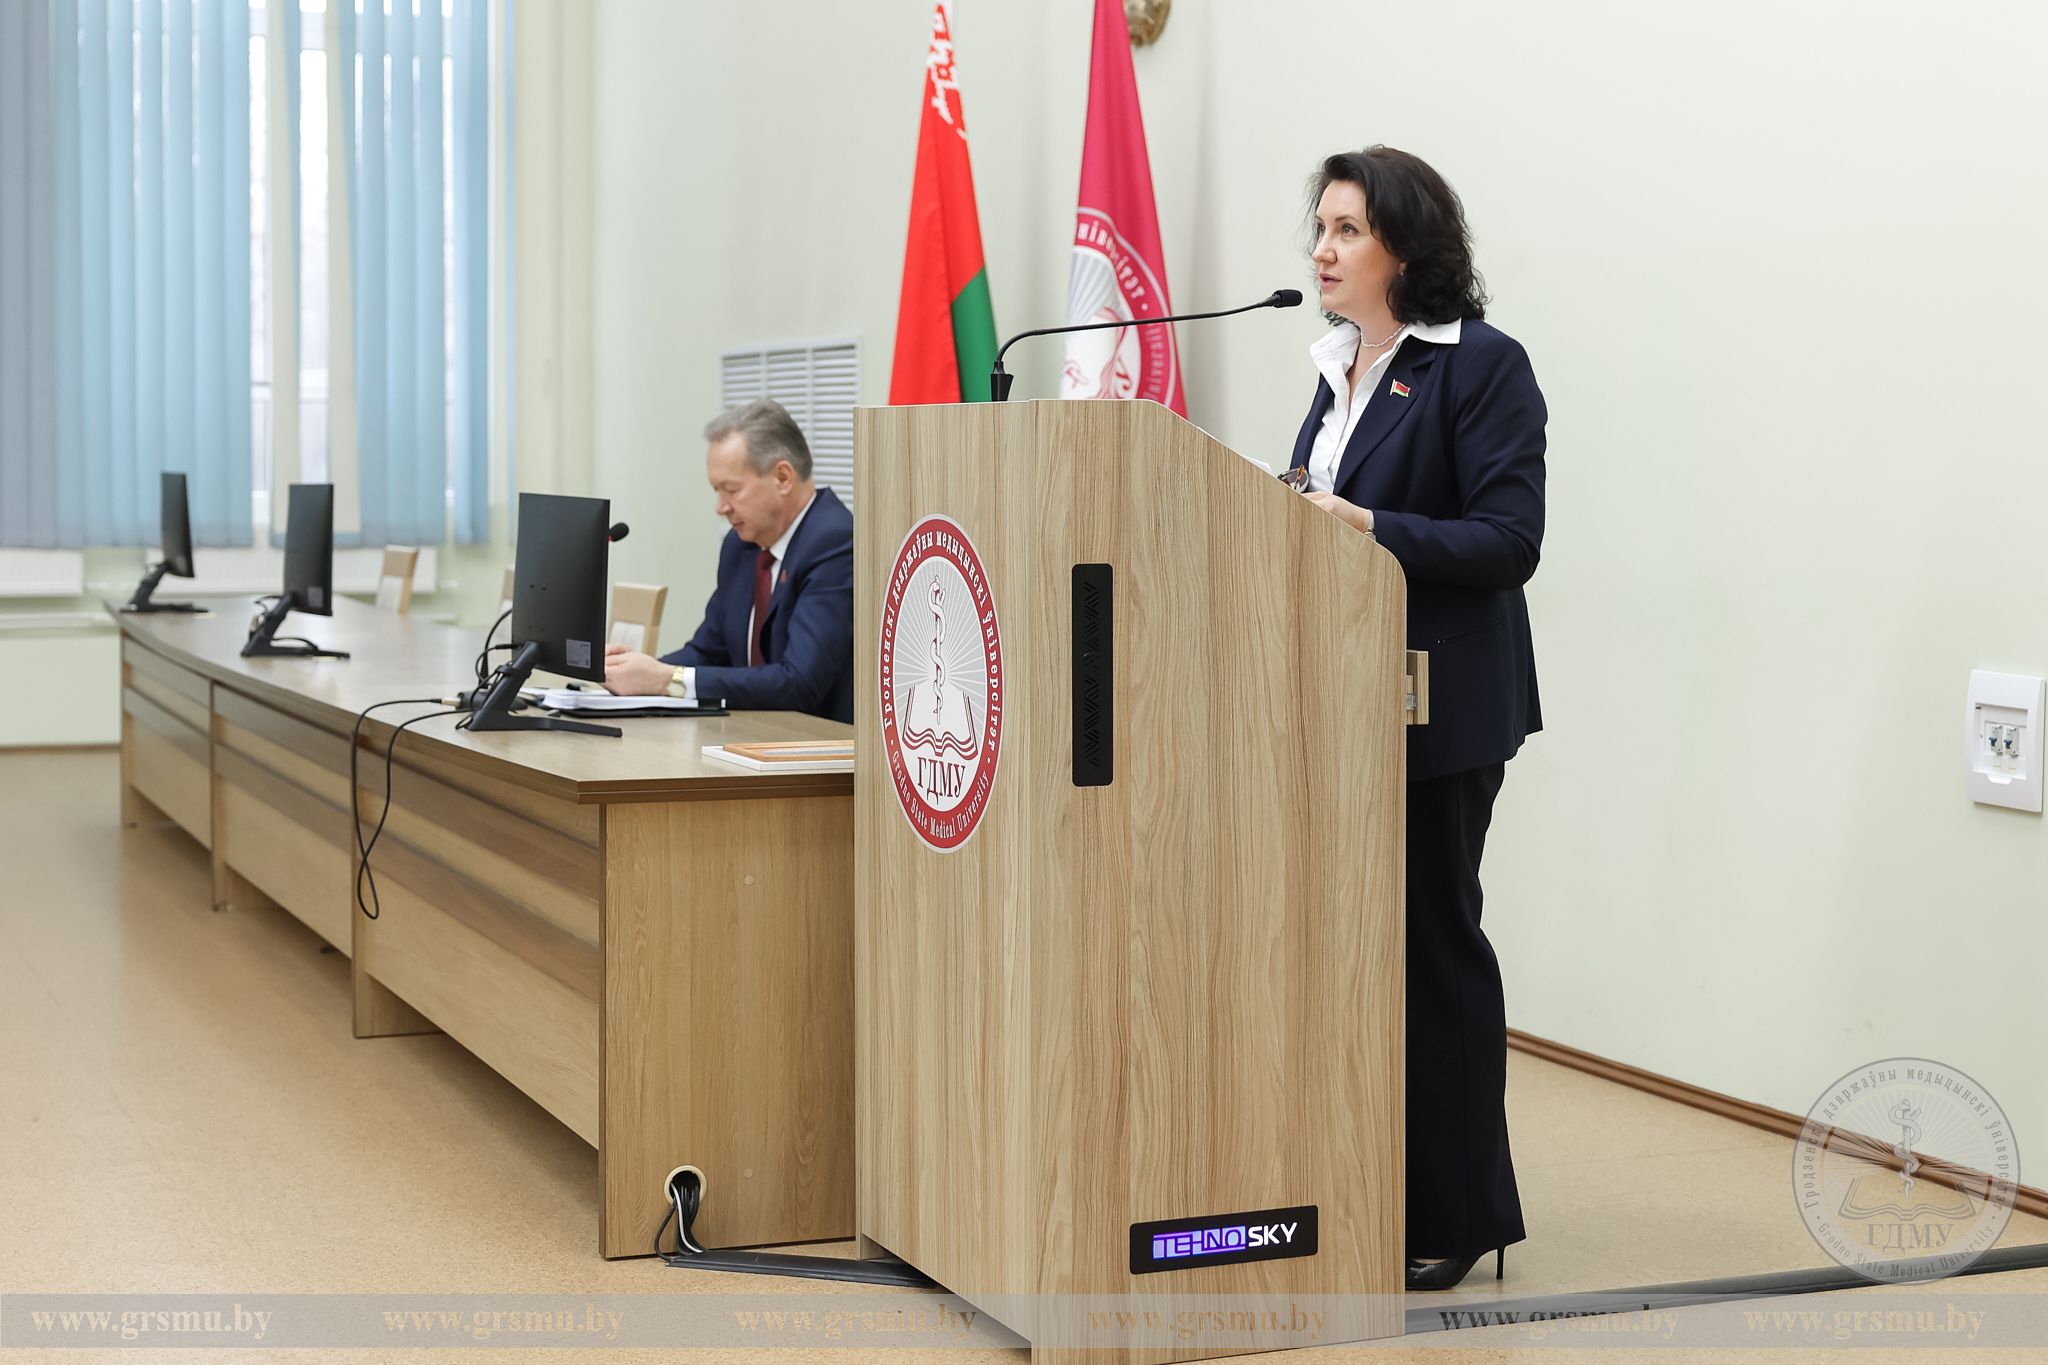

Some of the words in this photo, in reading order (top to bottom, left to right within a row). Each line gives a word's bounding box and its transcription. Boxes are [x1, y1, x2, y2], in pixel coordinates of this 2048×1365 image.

[883, 604, 895, 730] Гродзенскі
[892, 531, 934, 605] дзяржаўны
[936, 531, 988, 608] медыцынскі
[892, 750, 911, 803] Grodno
[911, 797, 928, 830] State
[930, 817, 956, 839] Medical
[957, 770, 990, 832] University
[917, 756, 966, 805] ГДМУ
